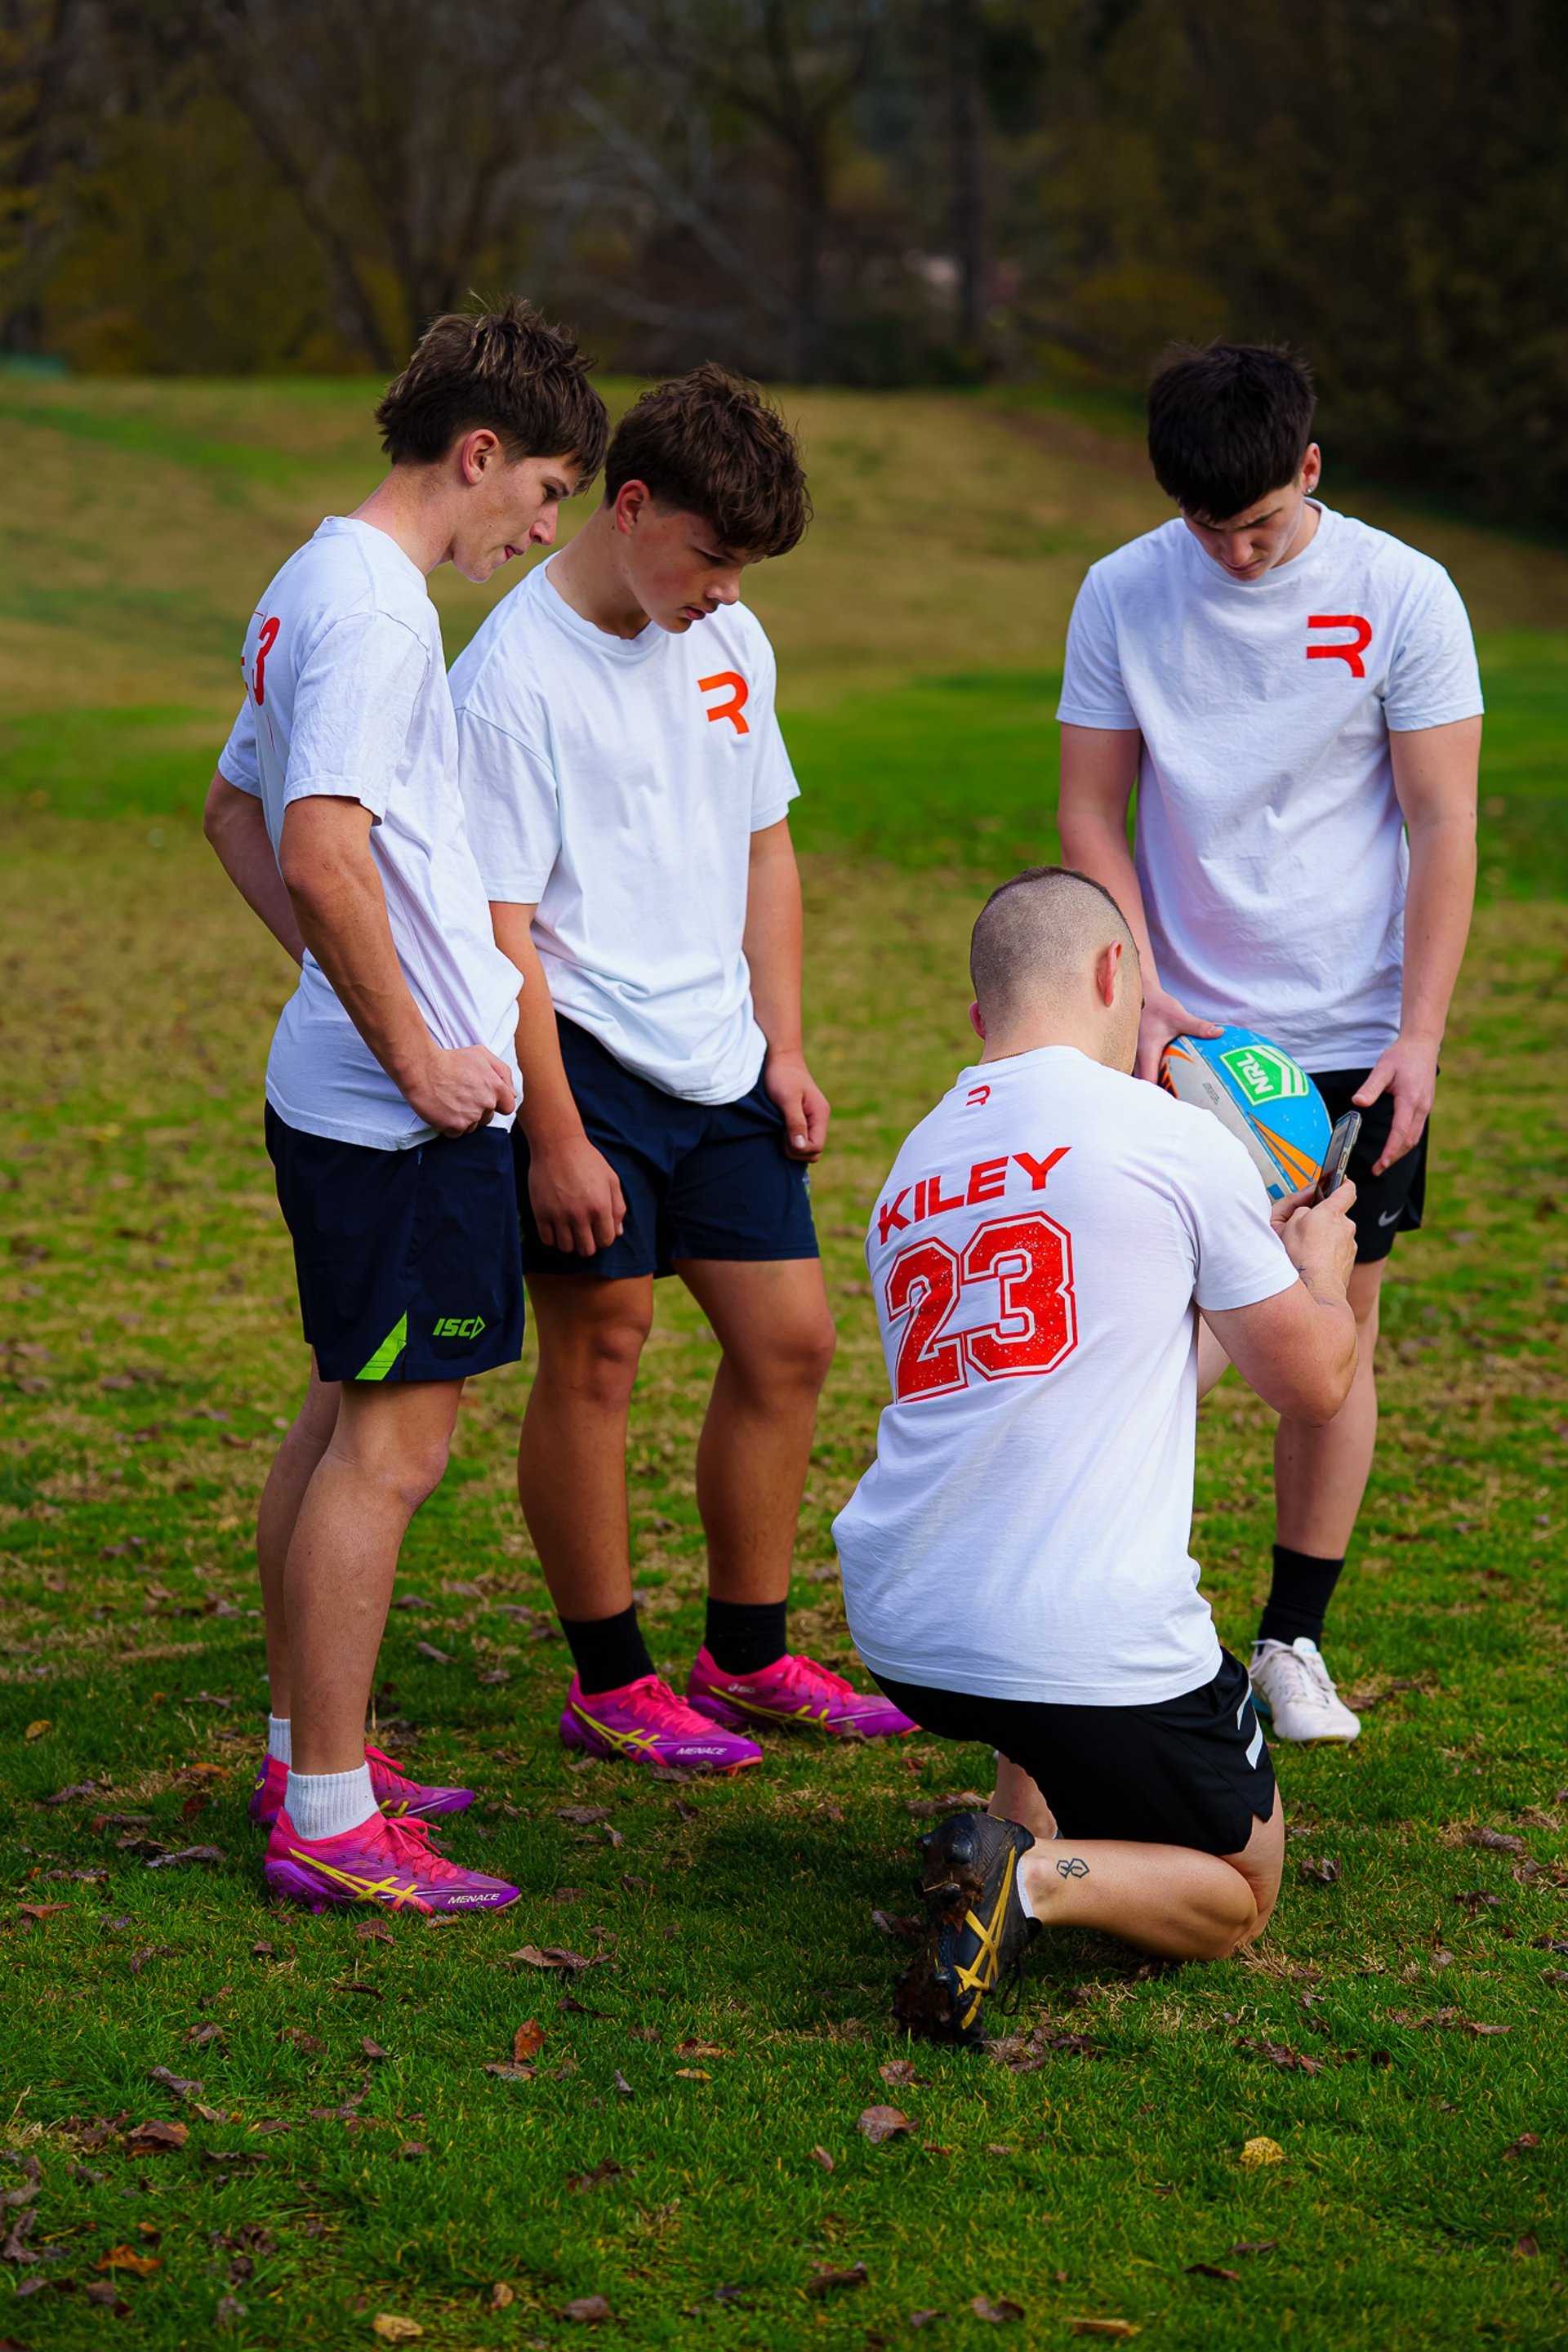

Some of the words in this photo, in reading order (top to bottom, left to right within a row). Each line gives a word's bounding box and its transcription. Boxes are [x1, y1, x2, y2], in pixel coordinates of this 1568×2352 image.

[1236, 1052, 1274, 1094] NRL
[877, 1147, 1072, 1246] KILEY
[884, 1210, 1078, 1405] 23
[432, 1317, 475, 1337] ISC
[676, 1747, 727, 1755] MENACE
[448, 1893, 500, 1904] MENACE
